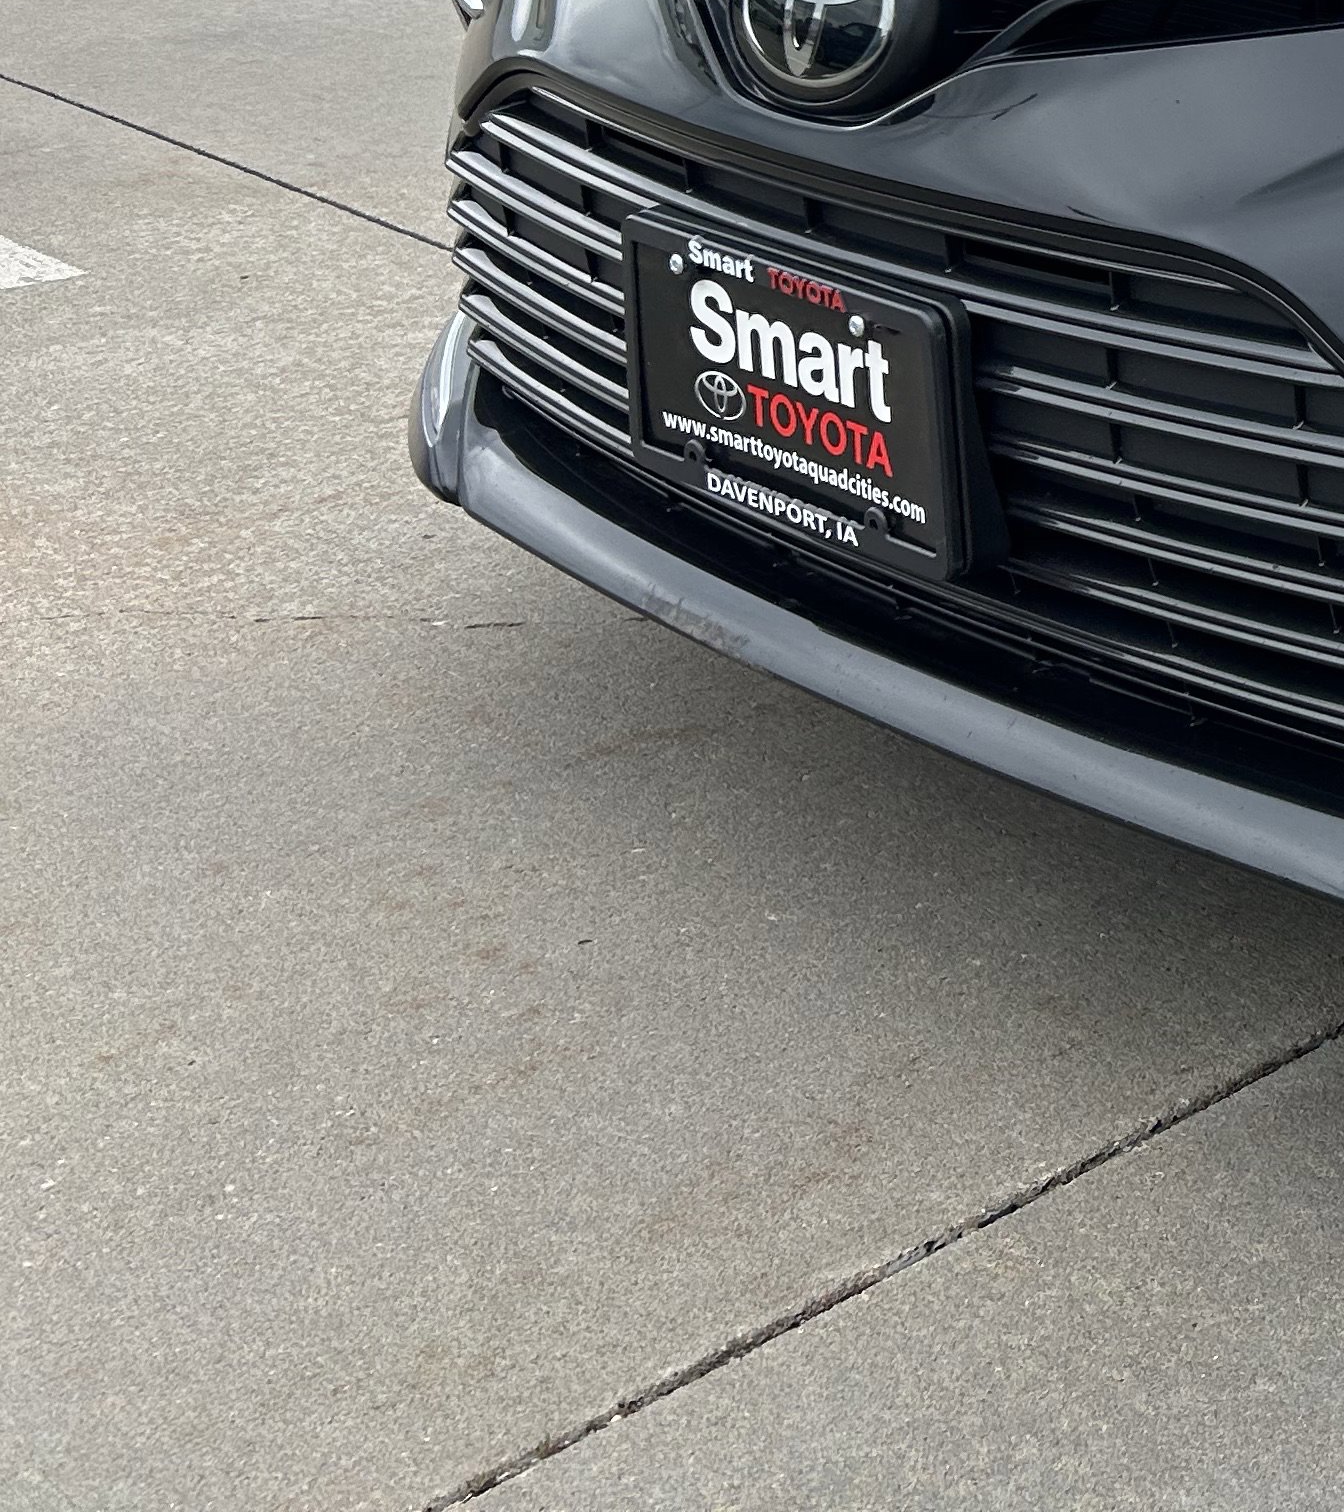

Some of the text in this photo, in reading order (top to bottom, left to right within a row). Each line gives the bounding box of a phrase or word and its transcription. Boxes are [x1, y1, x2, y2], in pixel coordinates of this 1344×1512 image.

[687, 237, 848, 313] Smart TOYOTA
[690, 278, 892, 423] Smart
[662, 410, 926, 524] www.smarttoyotaquadcities.com
[747, 384, 894, 478] TOYOTA
[706, 472, 860, 548] DAVENPORT, IA
